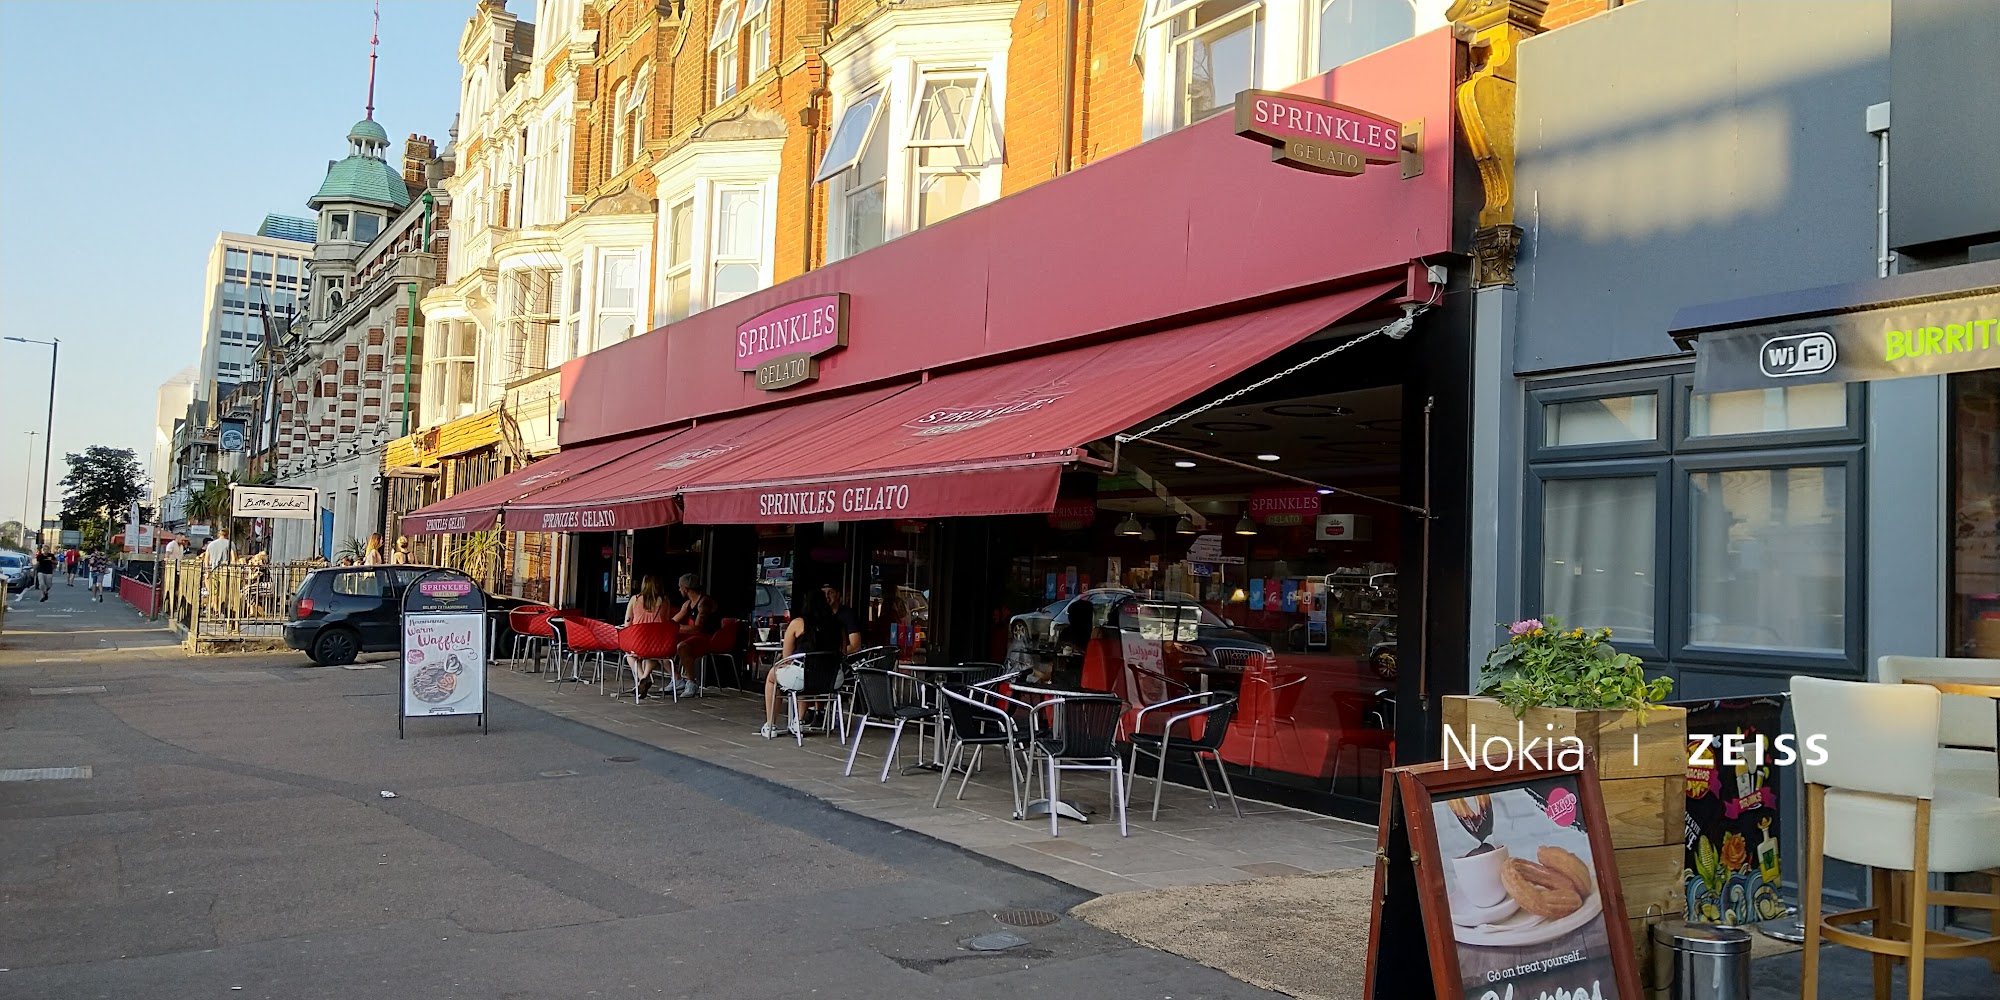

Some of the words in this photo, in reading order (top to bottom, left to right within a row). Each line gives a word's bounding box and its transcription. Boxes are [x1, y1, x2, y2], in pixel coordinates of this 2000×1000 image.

[1255, 99, 1397, 151] SPRINKLES
[1293, 143, 1359, 168] GELATO
[738, 304, 836, 359] SPRINKLES
[760, 358, 806, 385] GELATO
[760, 489, 837, 516] SPRINKLES
[842, 484, 909, 513] GELATO
[1252, 496, 1319, 511] SPRINKLES
[582, 509, 616, 528] GELATO
[1269, 515, 1300, 524] GELATO
[417, 630, 471, 651] Waffles!
[1487, 969, 1501, 982] Go
[1502, 968, 1516, 979] on
[1517, 960, 1541, 976] treat
